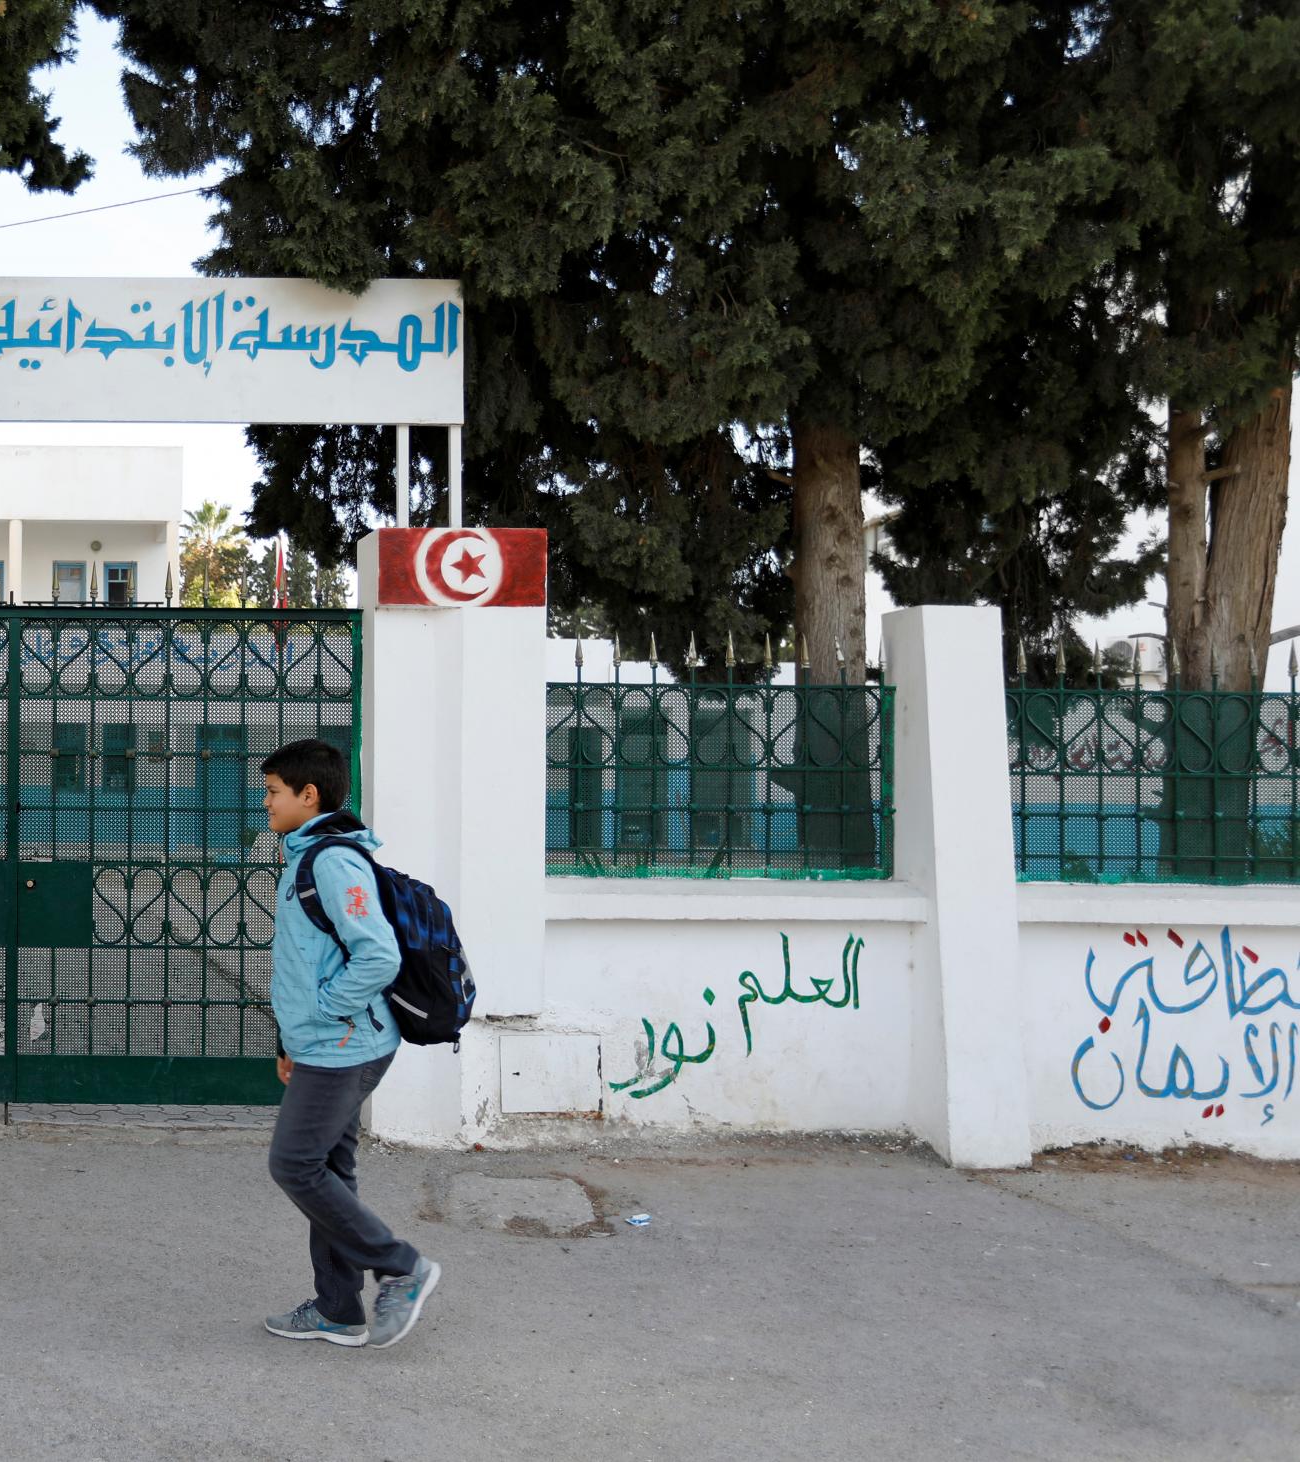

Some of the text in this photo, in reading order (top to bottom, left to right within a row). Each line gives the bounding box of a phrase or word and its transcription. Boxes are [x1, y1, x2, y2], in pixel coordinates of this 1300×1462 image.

[228, 296, 462, 373] المدرسة
[607, 931, 866, 1100] العلم نور
[1069, 996, 1299, 1128] الإيمان
